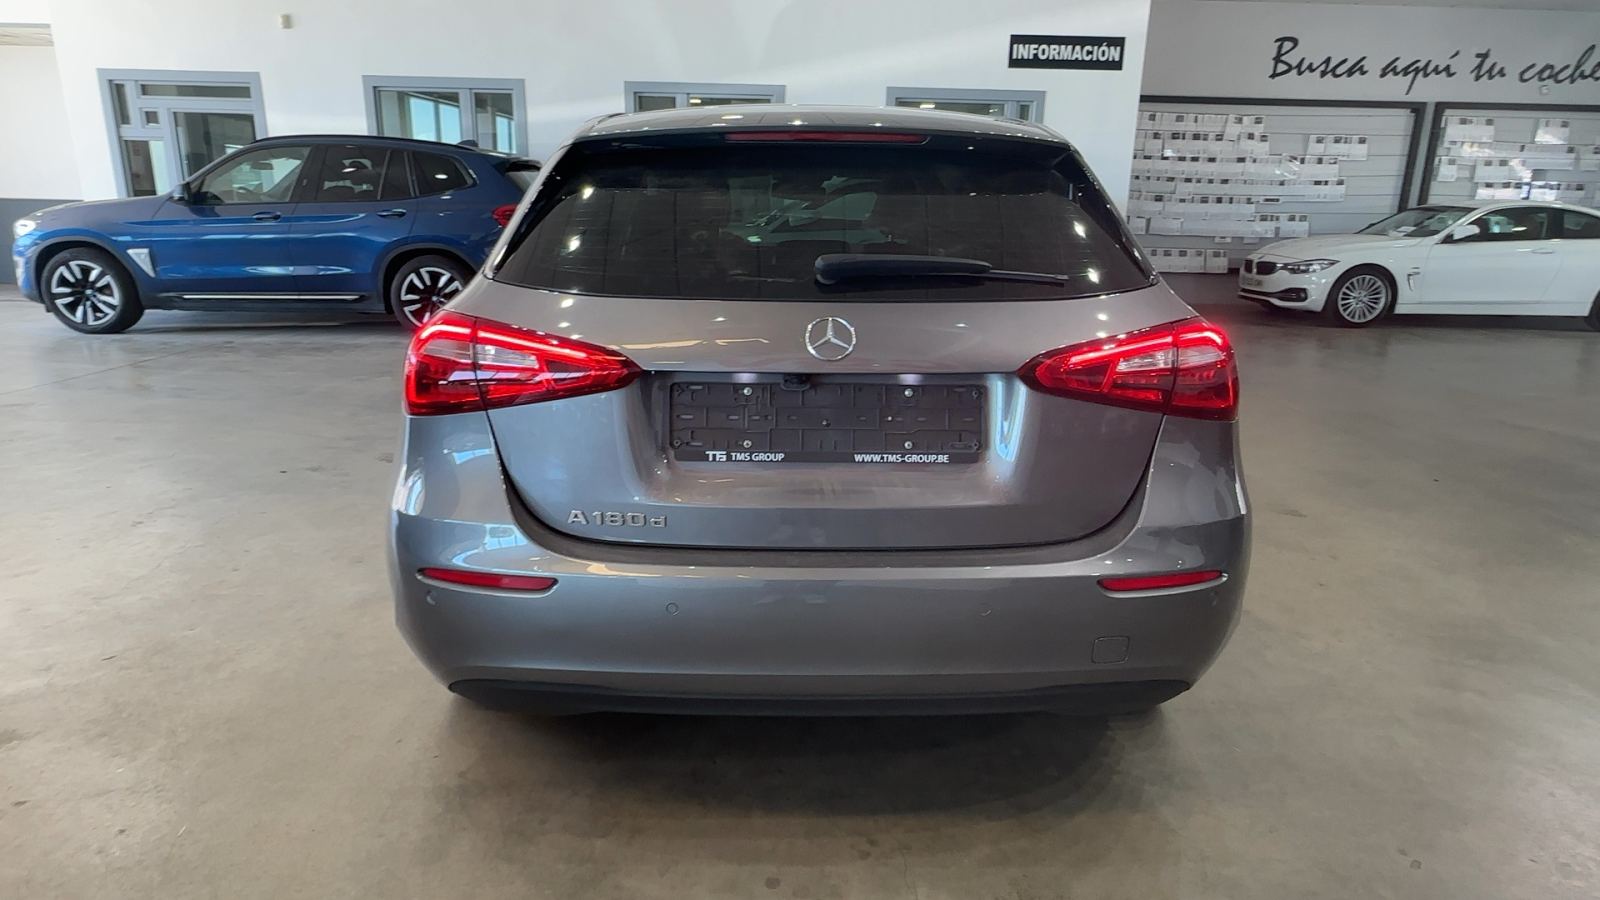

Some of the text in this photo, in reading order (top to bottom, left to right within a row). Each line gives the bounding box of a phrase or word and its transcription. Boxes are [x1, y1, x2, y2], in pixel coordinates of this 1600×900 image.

[1011, 41, 1121, 62] INFORMACIÓN
[1268, 36, 1369, 79] Busca
[1379, 49, 1459, 95] aquí
[1470, 48, 1507, 82] tu
[730, 452, 750, 462] TMS
[752, 452, 785, 462] GROUP
[854, 453, 950, 463] WWW.TMS-GROUP.BE
